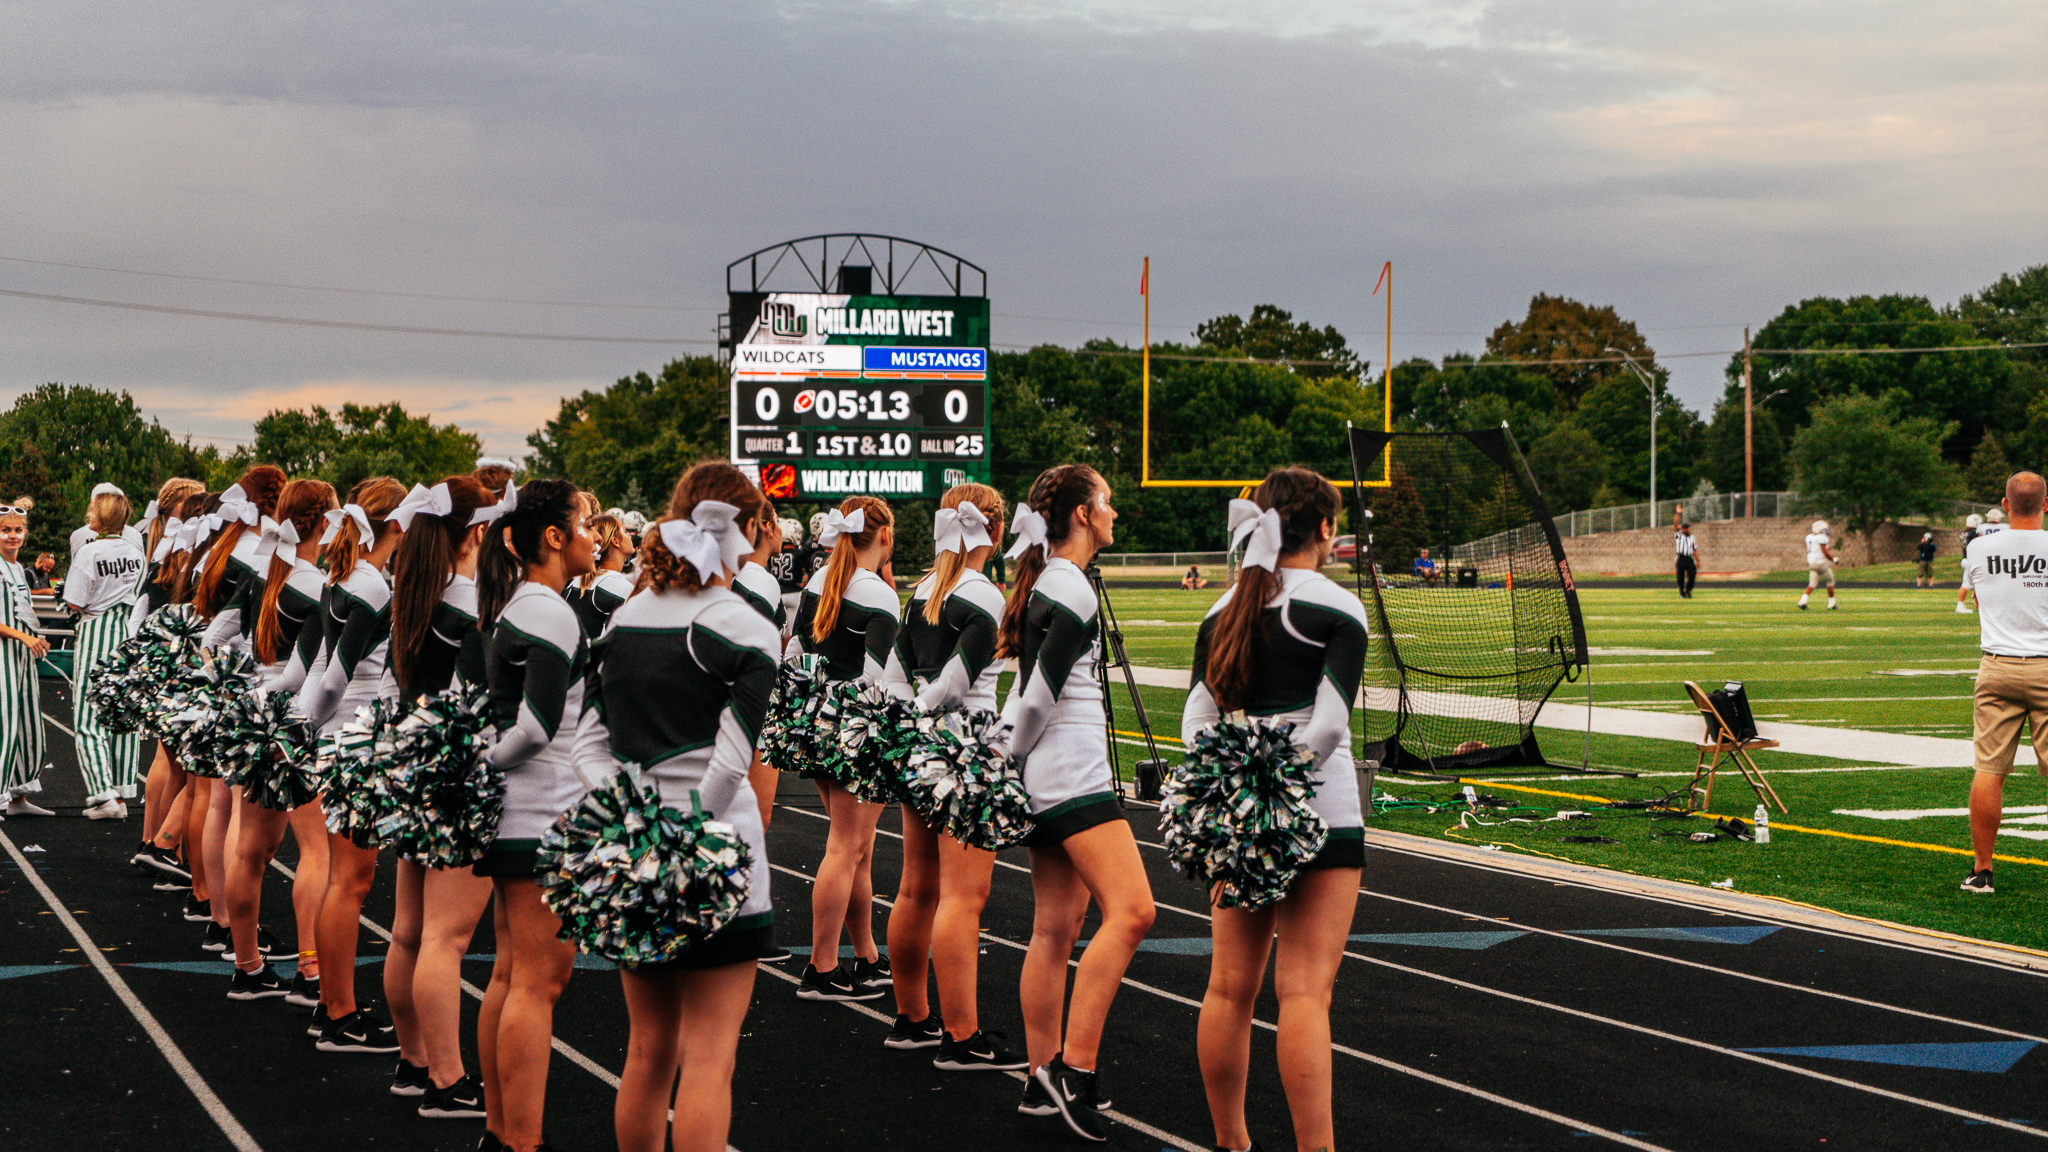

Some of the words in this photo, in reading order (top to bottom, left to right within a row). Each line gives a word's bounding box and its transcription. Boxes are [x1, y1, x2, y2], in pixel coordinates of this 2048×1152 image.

[816, 308, 899, 336] MILLARD
[901, 310, 955, 337] WEST
[742, 350, 825, 364] WILDCATS
[891, 352, 981, 367] MUSTANGS
[755, 387, 780, 421] 0
[815, 389, 910, 421] 05:13
[944, 389, 968, 423] 0
[745, 438, 784, 452] QUARTER
[786, 432, 803, 455] 1
[816, 436, 859, 456] 1ST
[860, 437, 877, 455] &
[878, 433, 912, 456] 10
[921, 439, 942, 453] BALL
[943, 440, 955, 453] ON
[955, 435, 984, 456] 25
[801, 470, 868, 493] WILDCAT
[869, 471, 923, 493] NATION
[771, 553, 793, 580] 52
[1987, 554, 2048, 579] HyVe
